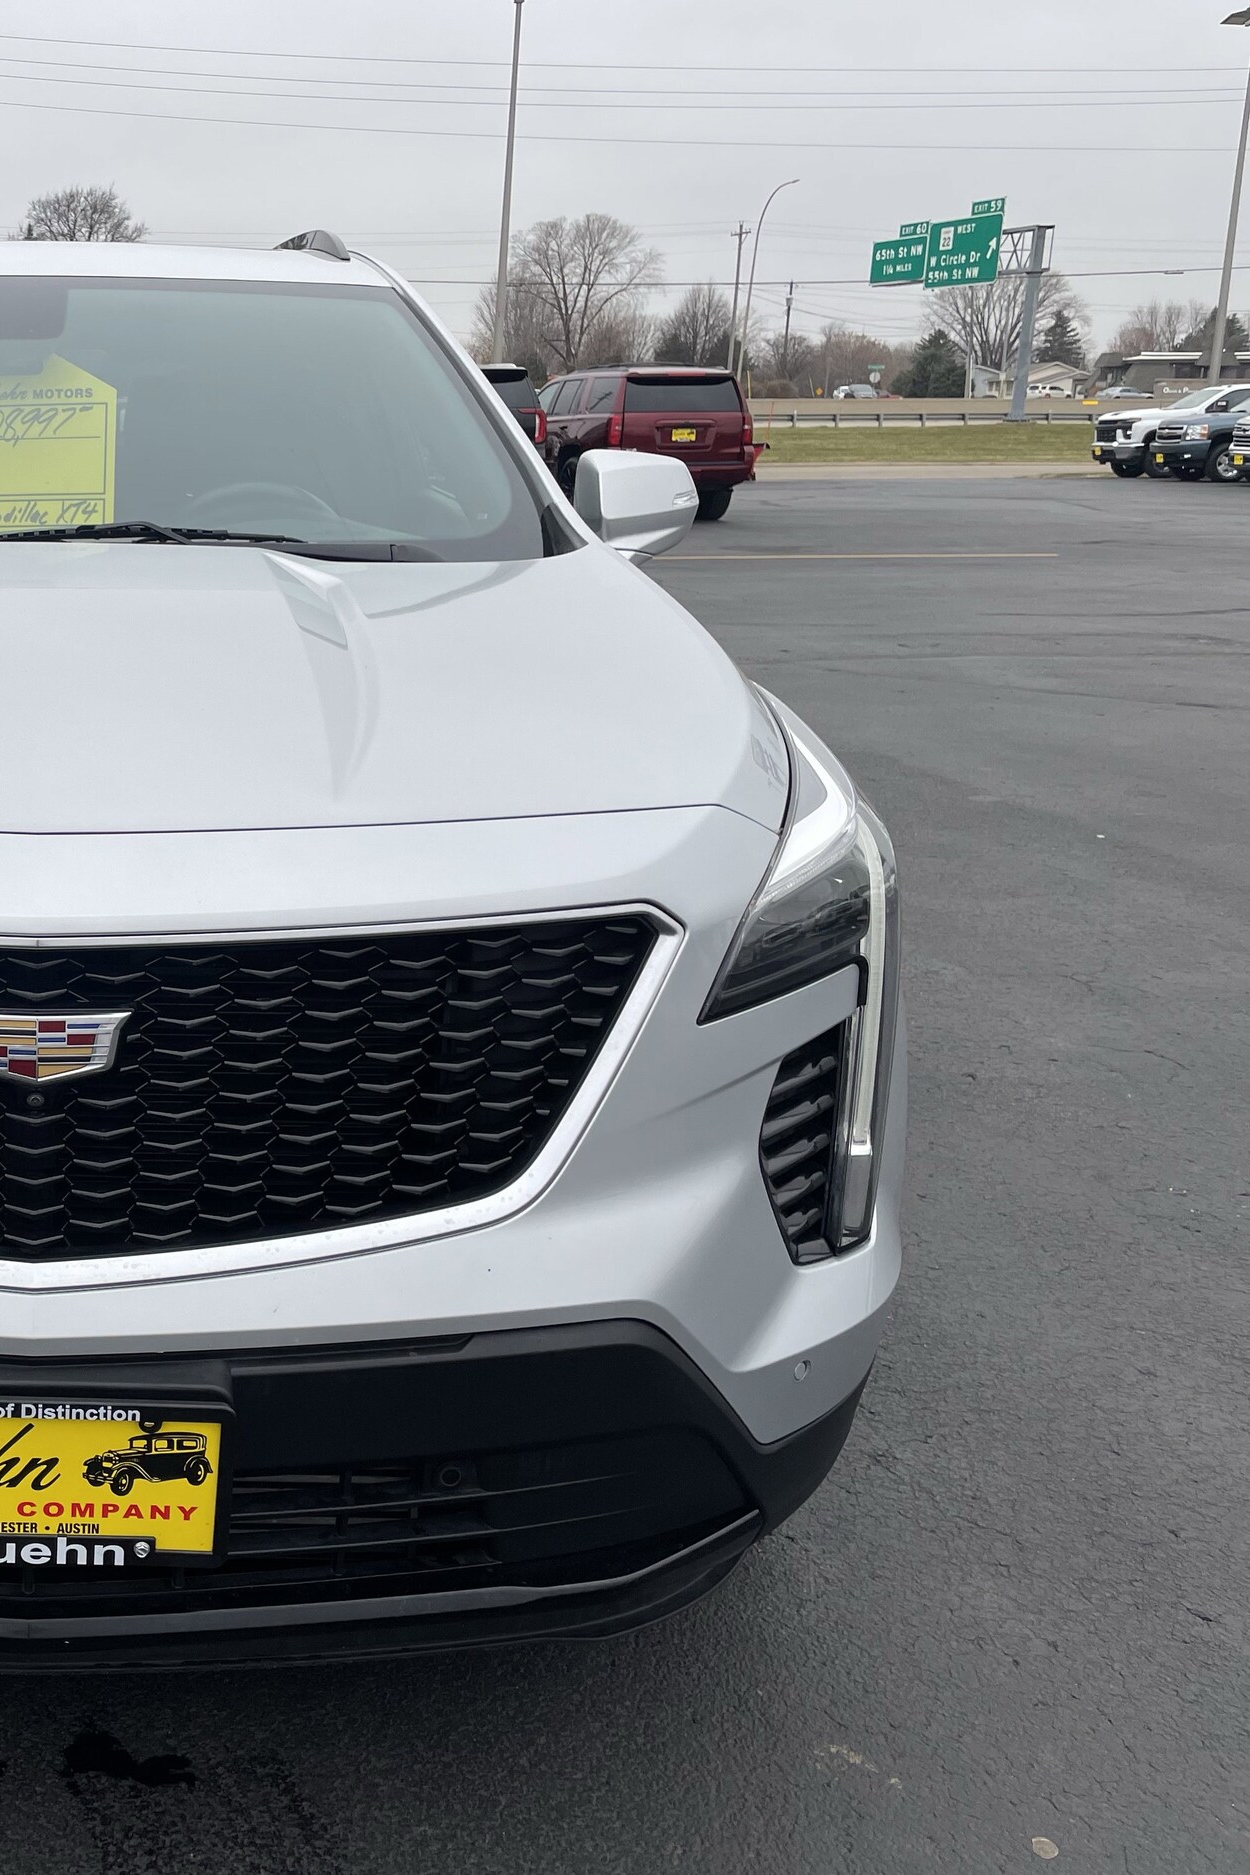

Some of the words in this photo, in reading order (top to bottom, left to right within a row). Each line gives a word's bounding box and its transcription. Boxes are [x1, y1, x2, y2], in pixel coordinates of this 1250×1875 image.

[974, 203, 989, 213] EXIT
[990, 200, 1002, 212] 59
[901, 225, 914, 236] EXIT
[916, 223, 927, 234] 60
[957, 223, 976, 234] WEST
[942, 237, 951, 247] 22
[875, 246, 895, 261] 65th
[898, 245, 908, 258] St
[910, 244, 924, 257] NW
[930, 256, 939, 268] W
[940, 253, 966, 266] Circle
[969, 251, 981, 263] Dr
[896, 263, 912, 272] MILES
[928, 270, 949, 283] 55th
[952, 268, 962, 280] St
[965, 267, 979, 279] NW
[32, 387, 94, 400] MOTORS
[56, 499, 99, 524] XT4
[20, 1402, 141, 1423] Distinction
[17, 1500, 199, 1522] COMPANY
[56, 1521, 100, 1535] AUSTIN
